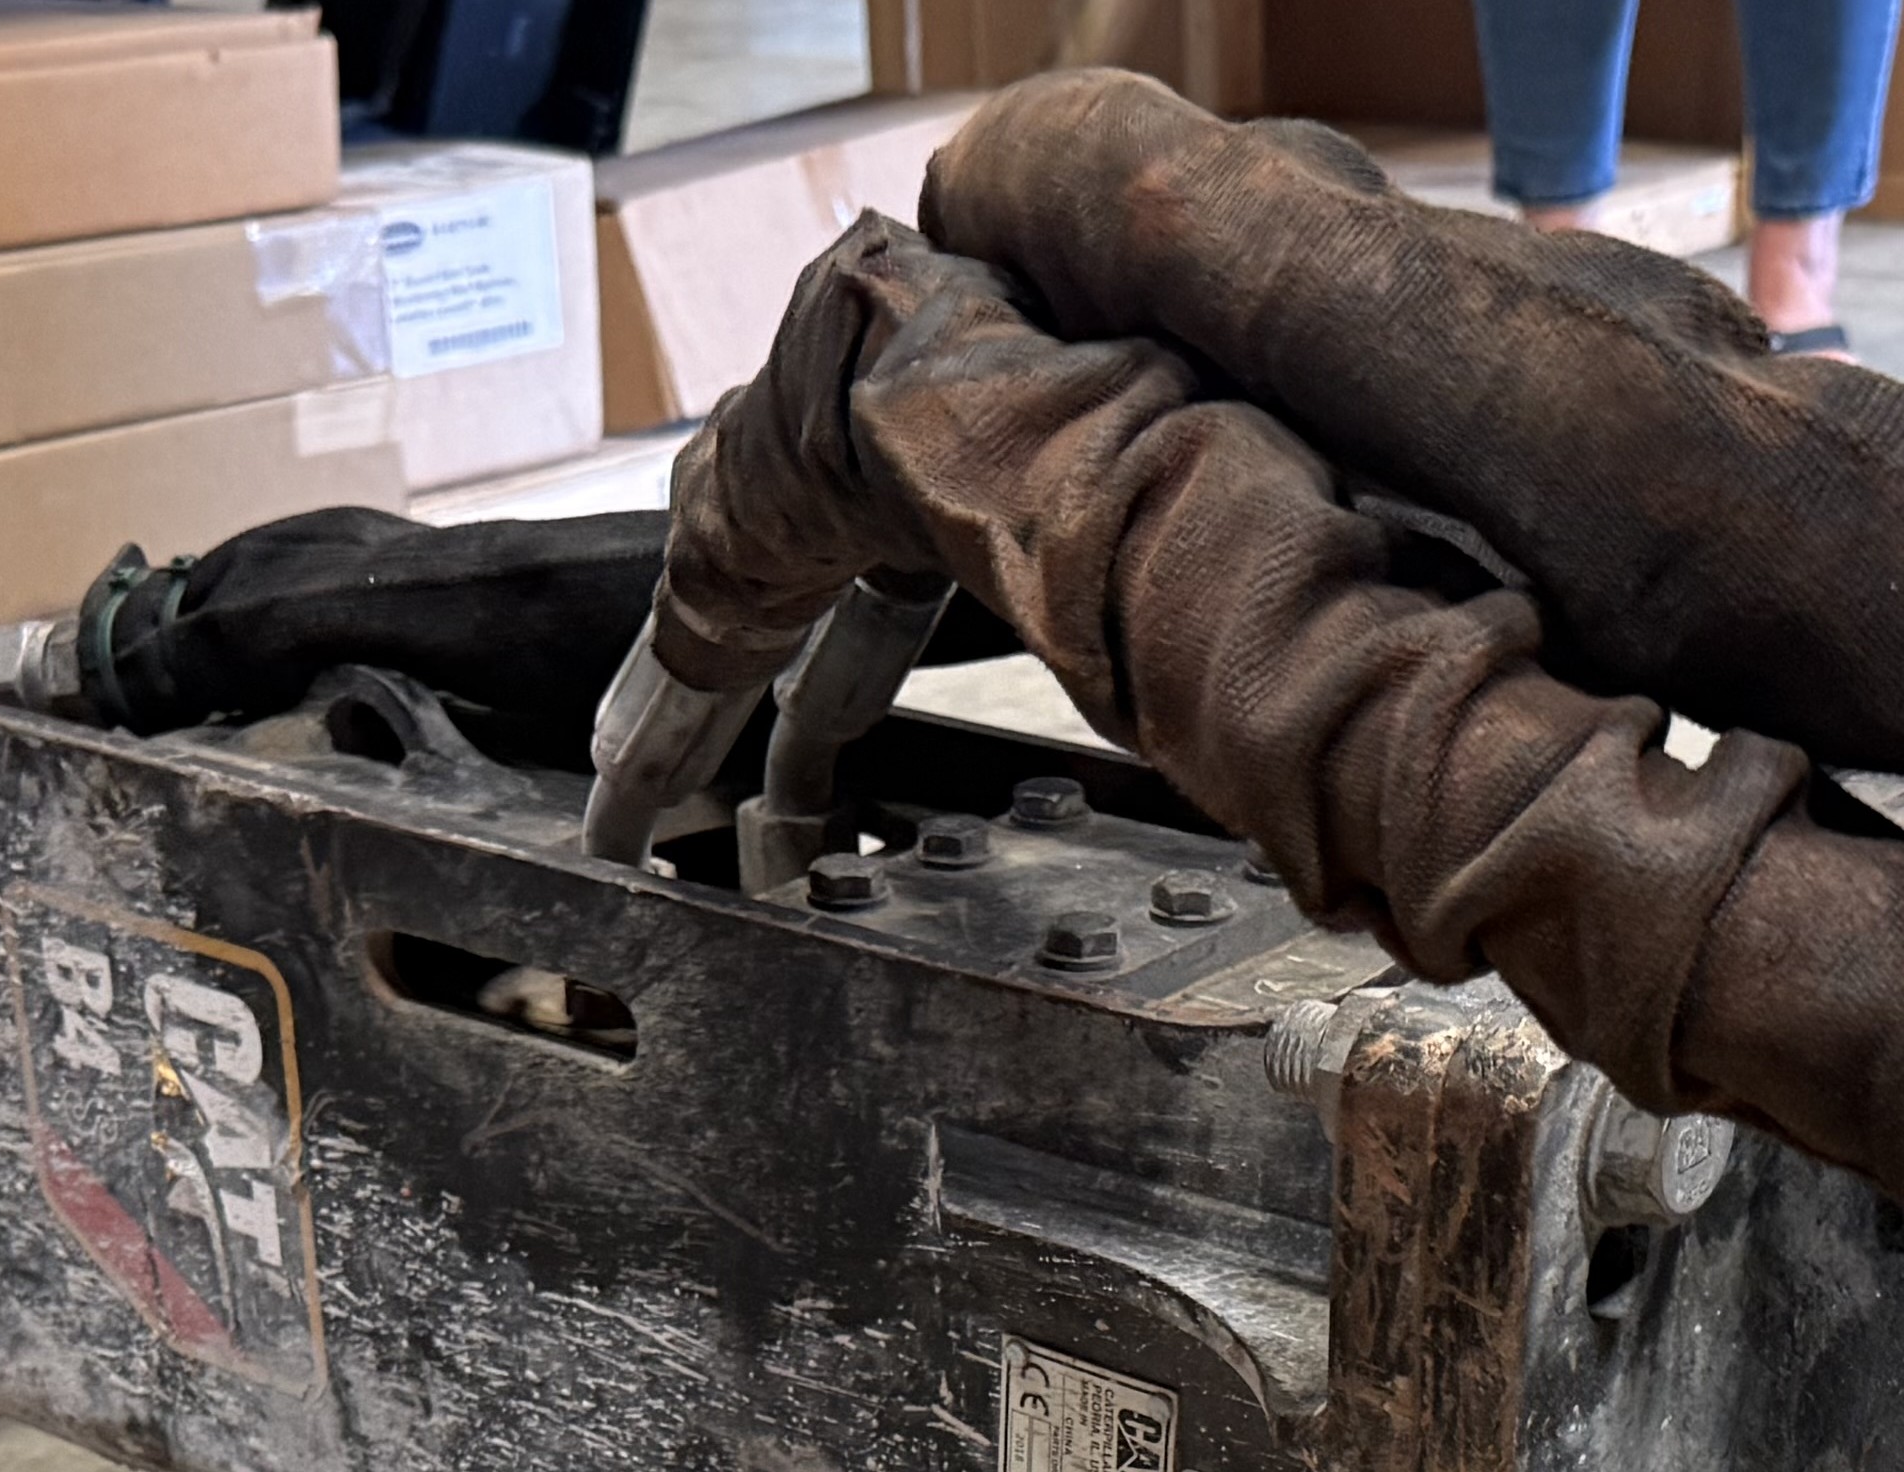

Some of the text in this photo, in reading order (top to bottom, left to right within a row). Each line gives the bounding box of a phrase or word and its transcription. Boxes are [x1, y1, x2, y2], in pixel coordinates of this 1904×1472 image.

[144, 973, 283, 1266] CAT
[1079, 1378, 1088, 1427] MADE IN
[1064, 1415, 1073, 1457] CHINA
